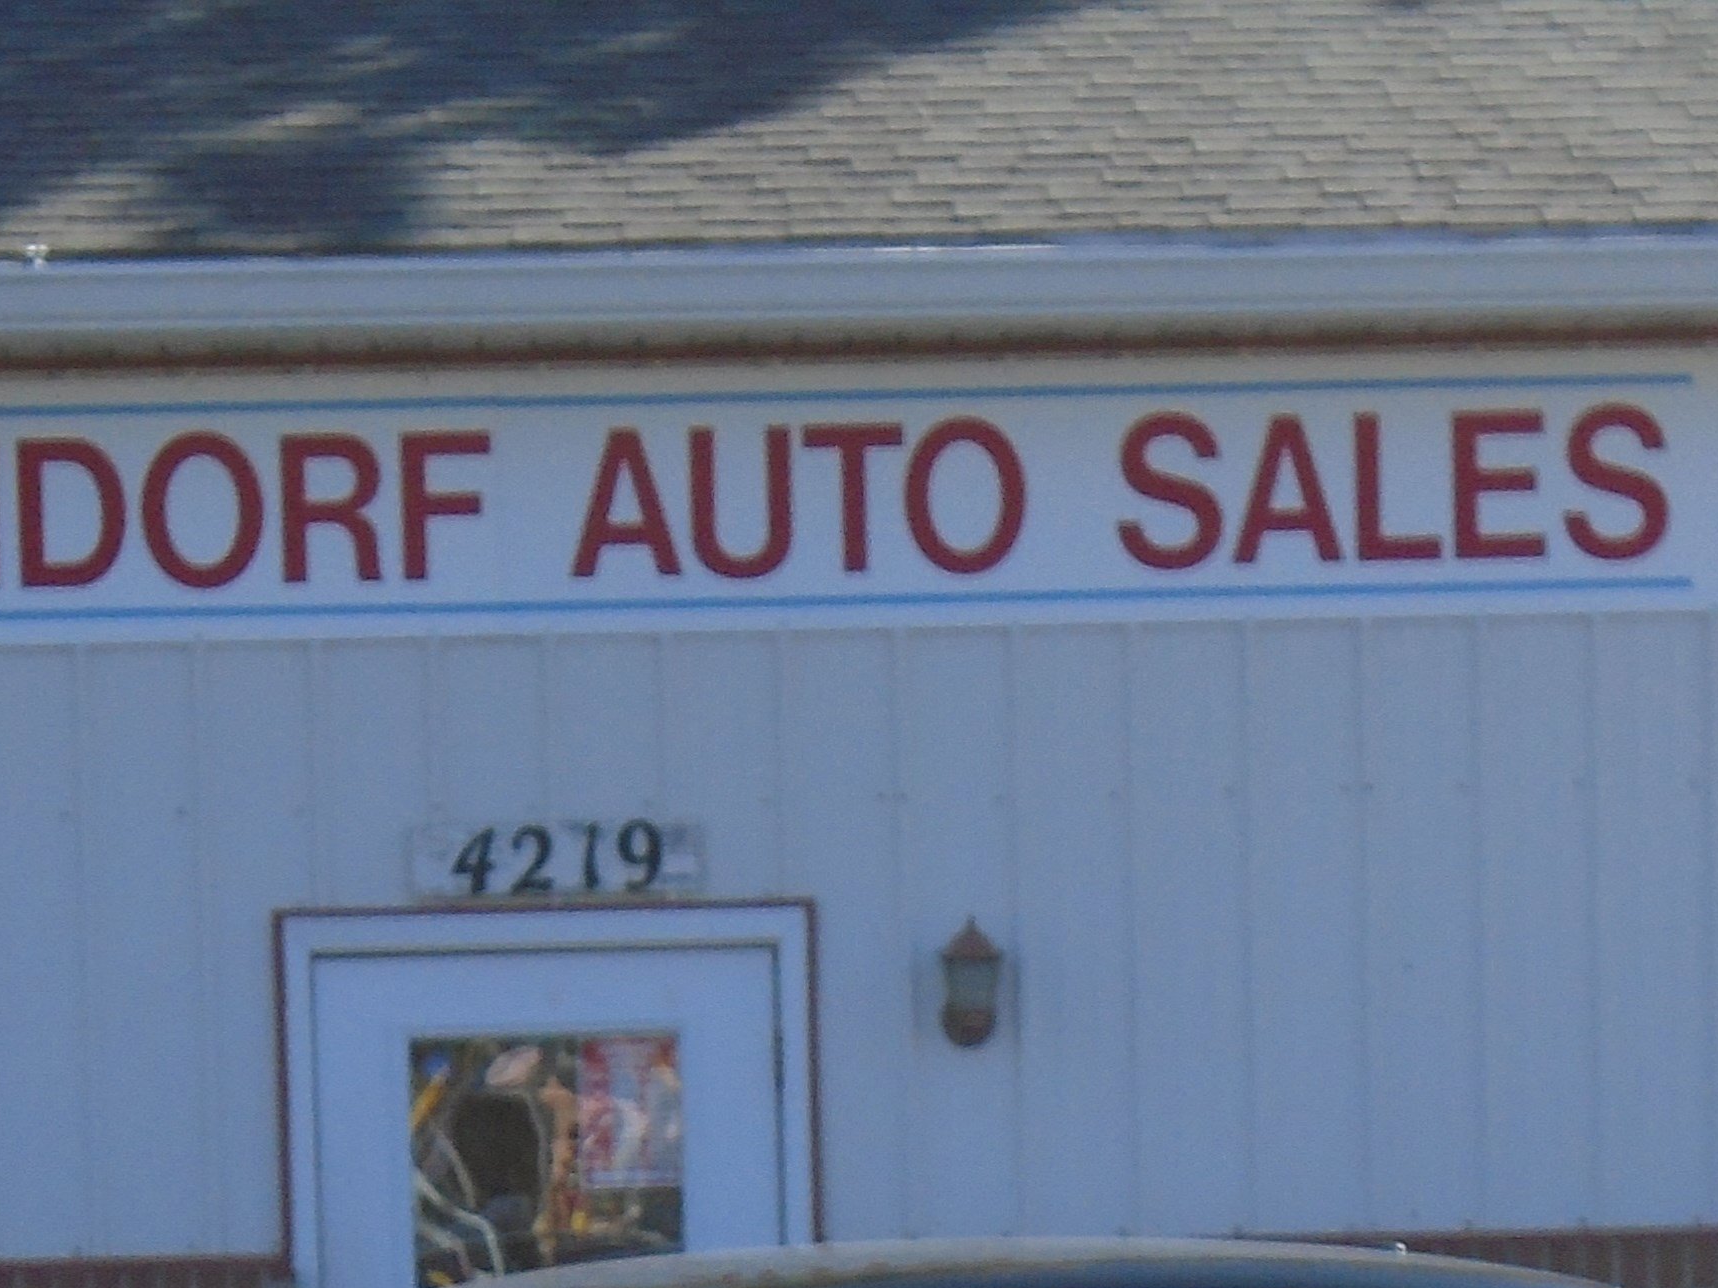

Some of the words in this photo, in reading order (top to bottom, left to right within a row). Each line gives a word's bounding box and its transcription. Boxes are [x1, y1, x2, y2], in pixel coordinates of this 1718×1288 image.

[571, 416, 1027, 578] AUTO
[1116, 403, 1670, 570] SALES
[450, 818, 663, 894] 4219
